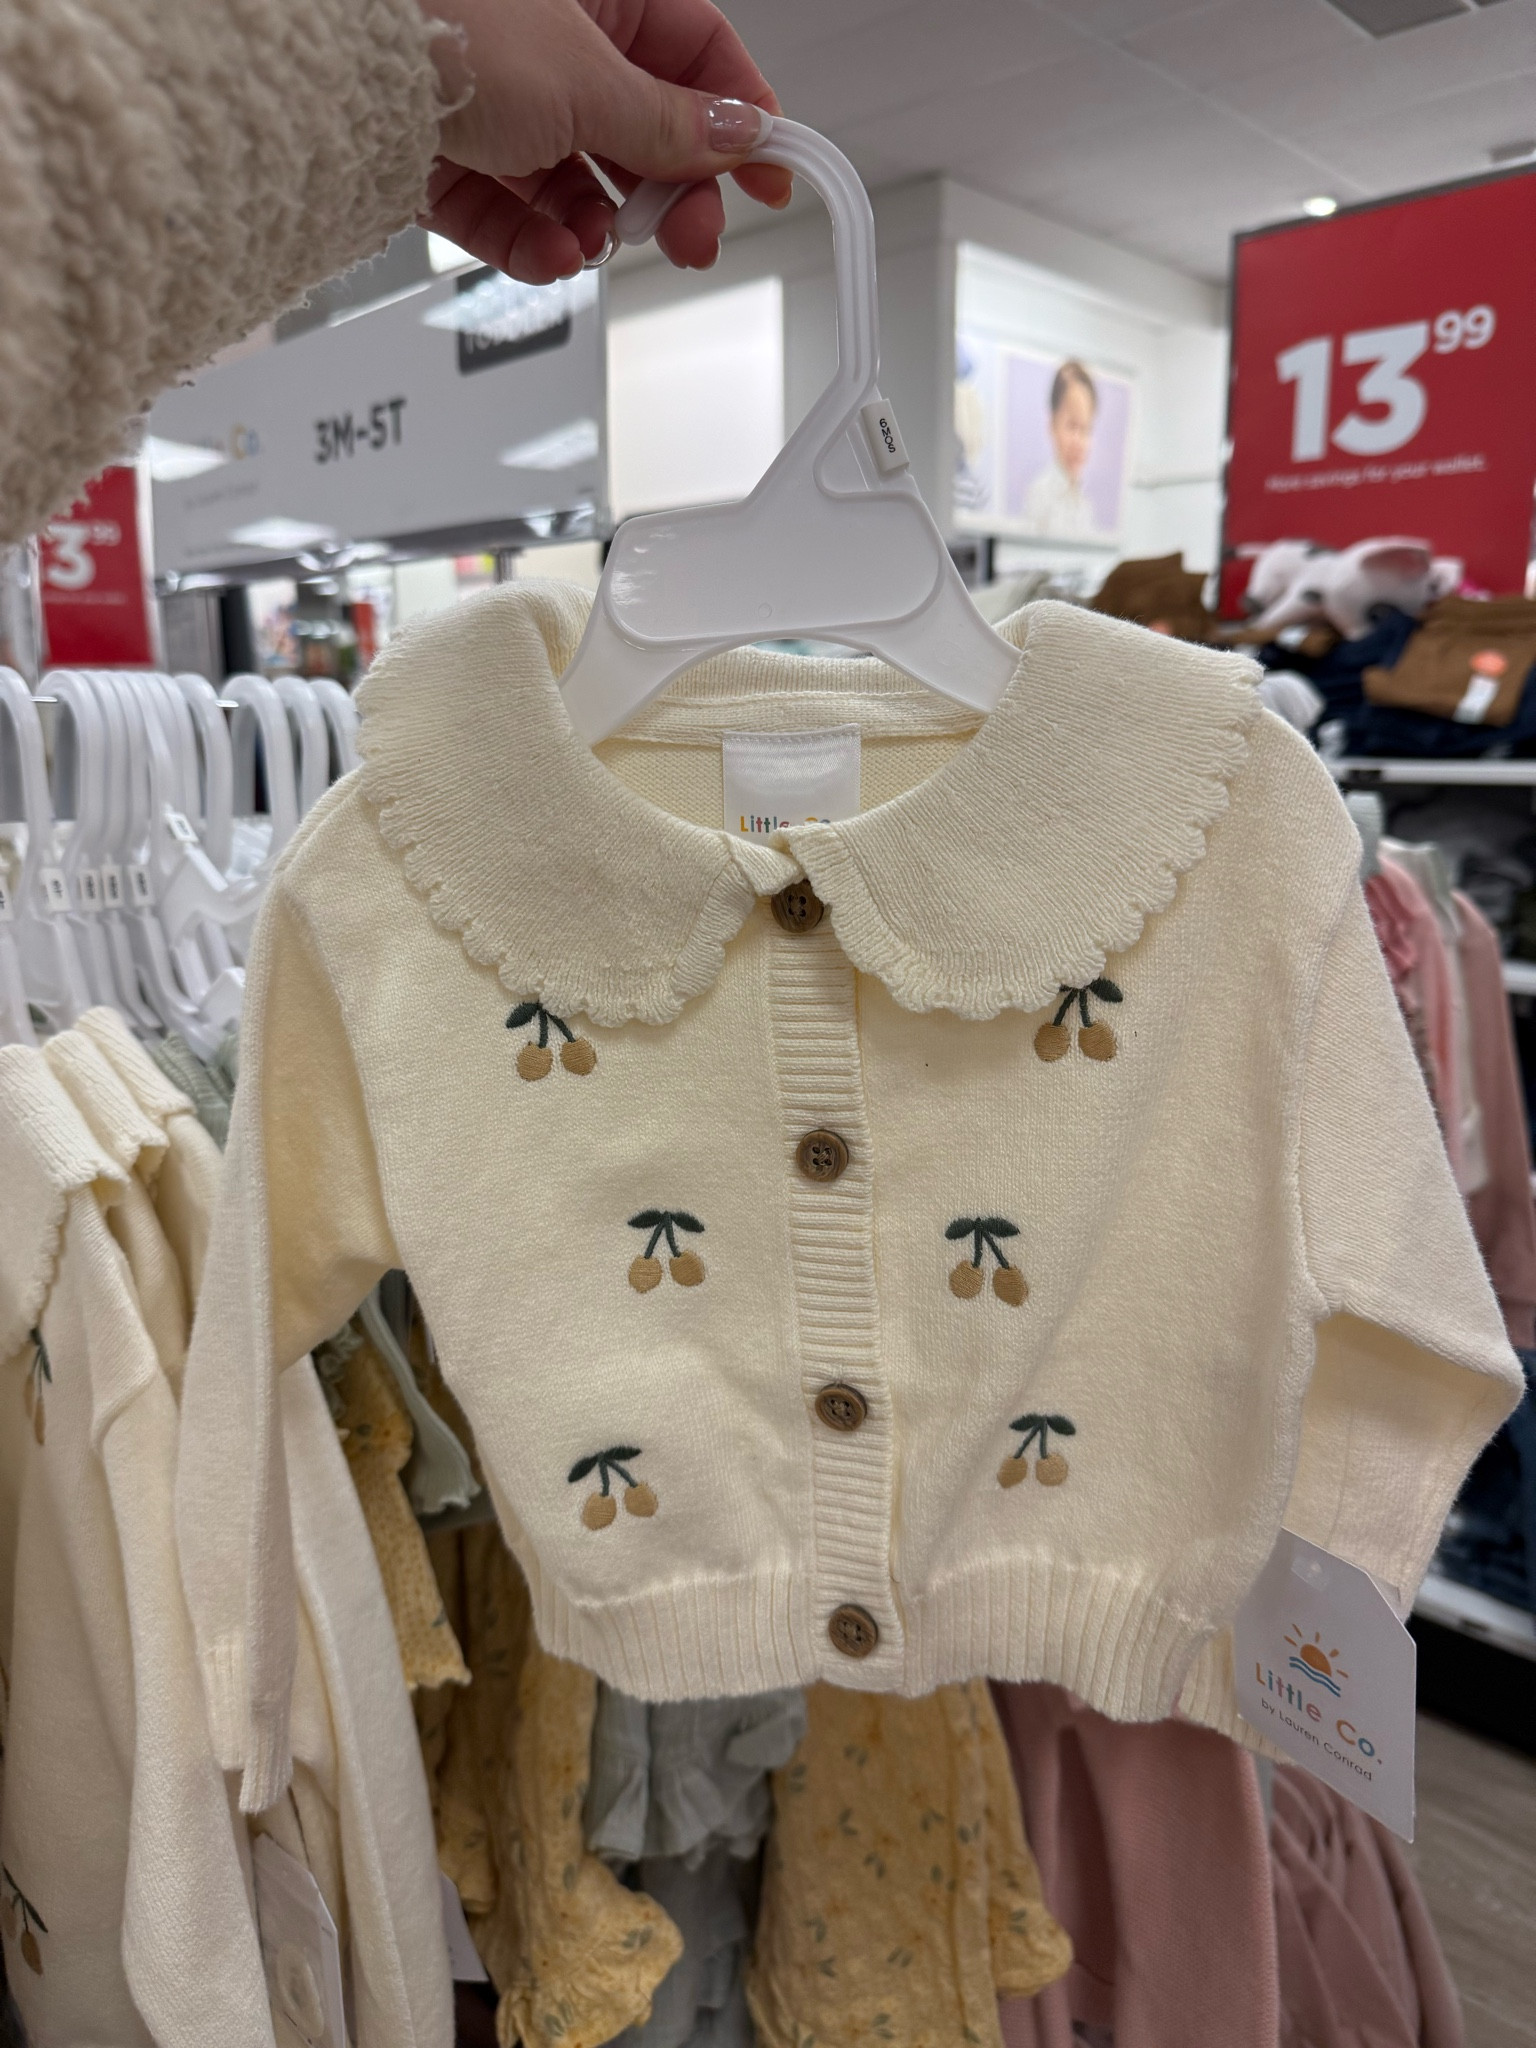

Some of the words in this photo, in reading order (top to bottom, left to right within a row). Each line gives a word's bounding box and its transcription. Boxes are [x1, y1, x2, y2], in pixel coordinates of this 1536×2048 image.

[1275, 319, 1430, 463] 13
[315, 397, 407, 464] 3M-5T
[879, 418, 896, 453] 6MOS
[1255, 1662, 1322, 1722] Little
[1261, 1697, 1275, 1714] by
[1279, 1711, 1319, 1745] Lauren
[1323, 1742, 1372, 1781] Conrad
